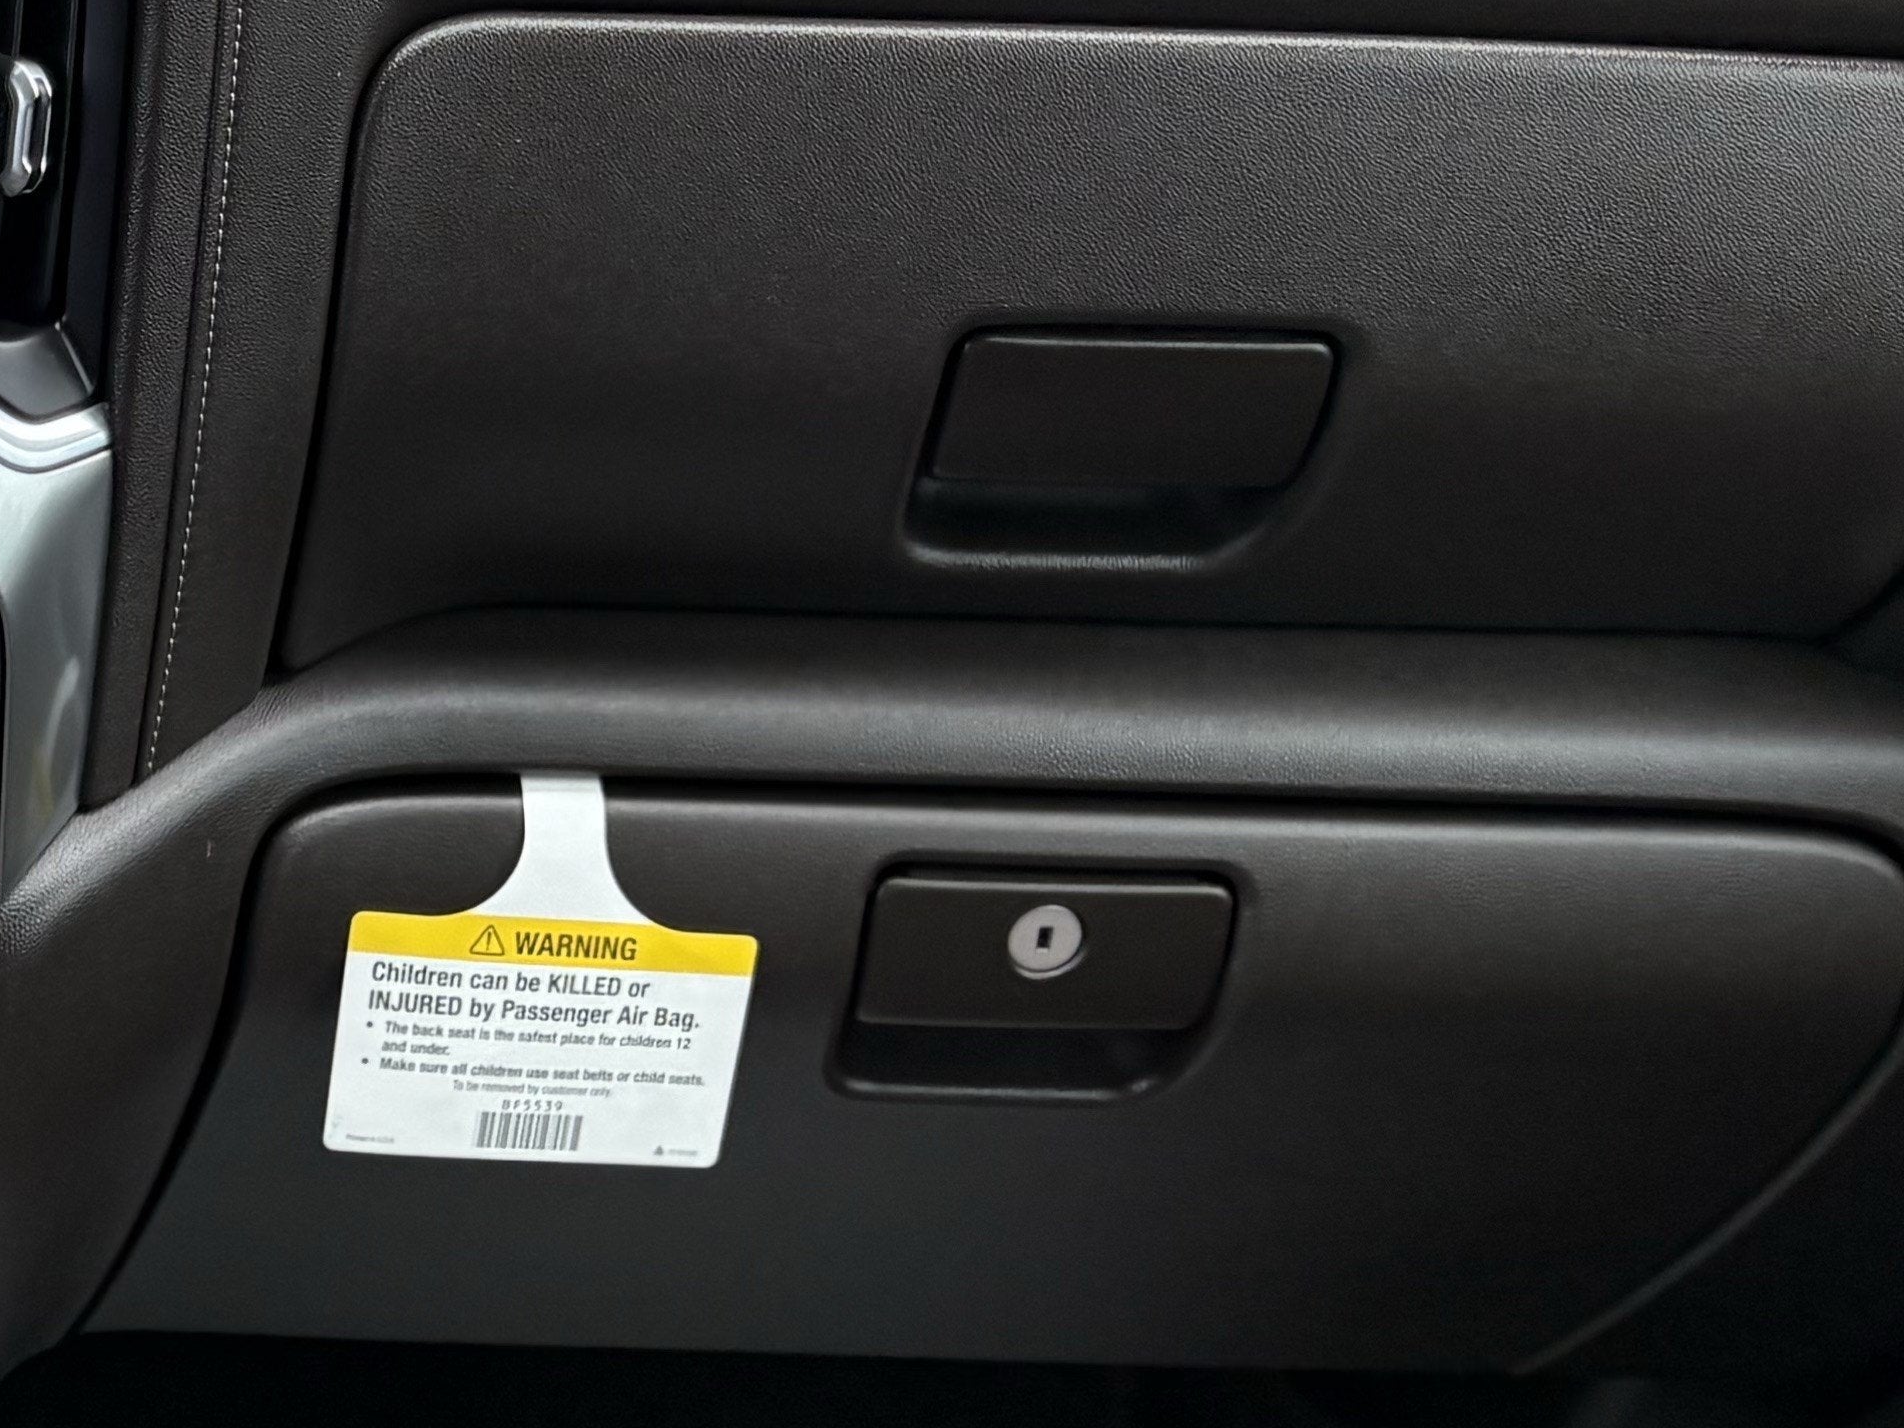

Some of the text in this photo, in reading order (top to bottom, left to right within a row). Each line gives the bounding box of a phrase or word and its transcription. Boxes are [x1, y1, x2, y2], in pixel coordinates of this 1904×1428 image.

[515, 931, 637, 961] WARNING
[372, 961, 651, 998] Children can be KILLED or
[368, 989, 700, 1032] INJURED by Passenger Air Bag.
[381, 1040, 451, 1056] and under.
[384, 1021, 692, 1050] The back seat is the safest place for children 12
[379, 1057, 705, 1086] Make sure all children use seat belts or child seats.
